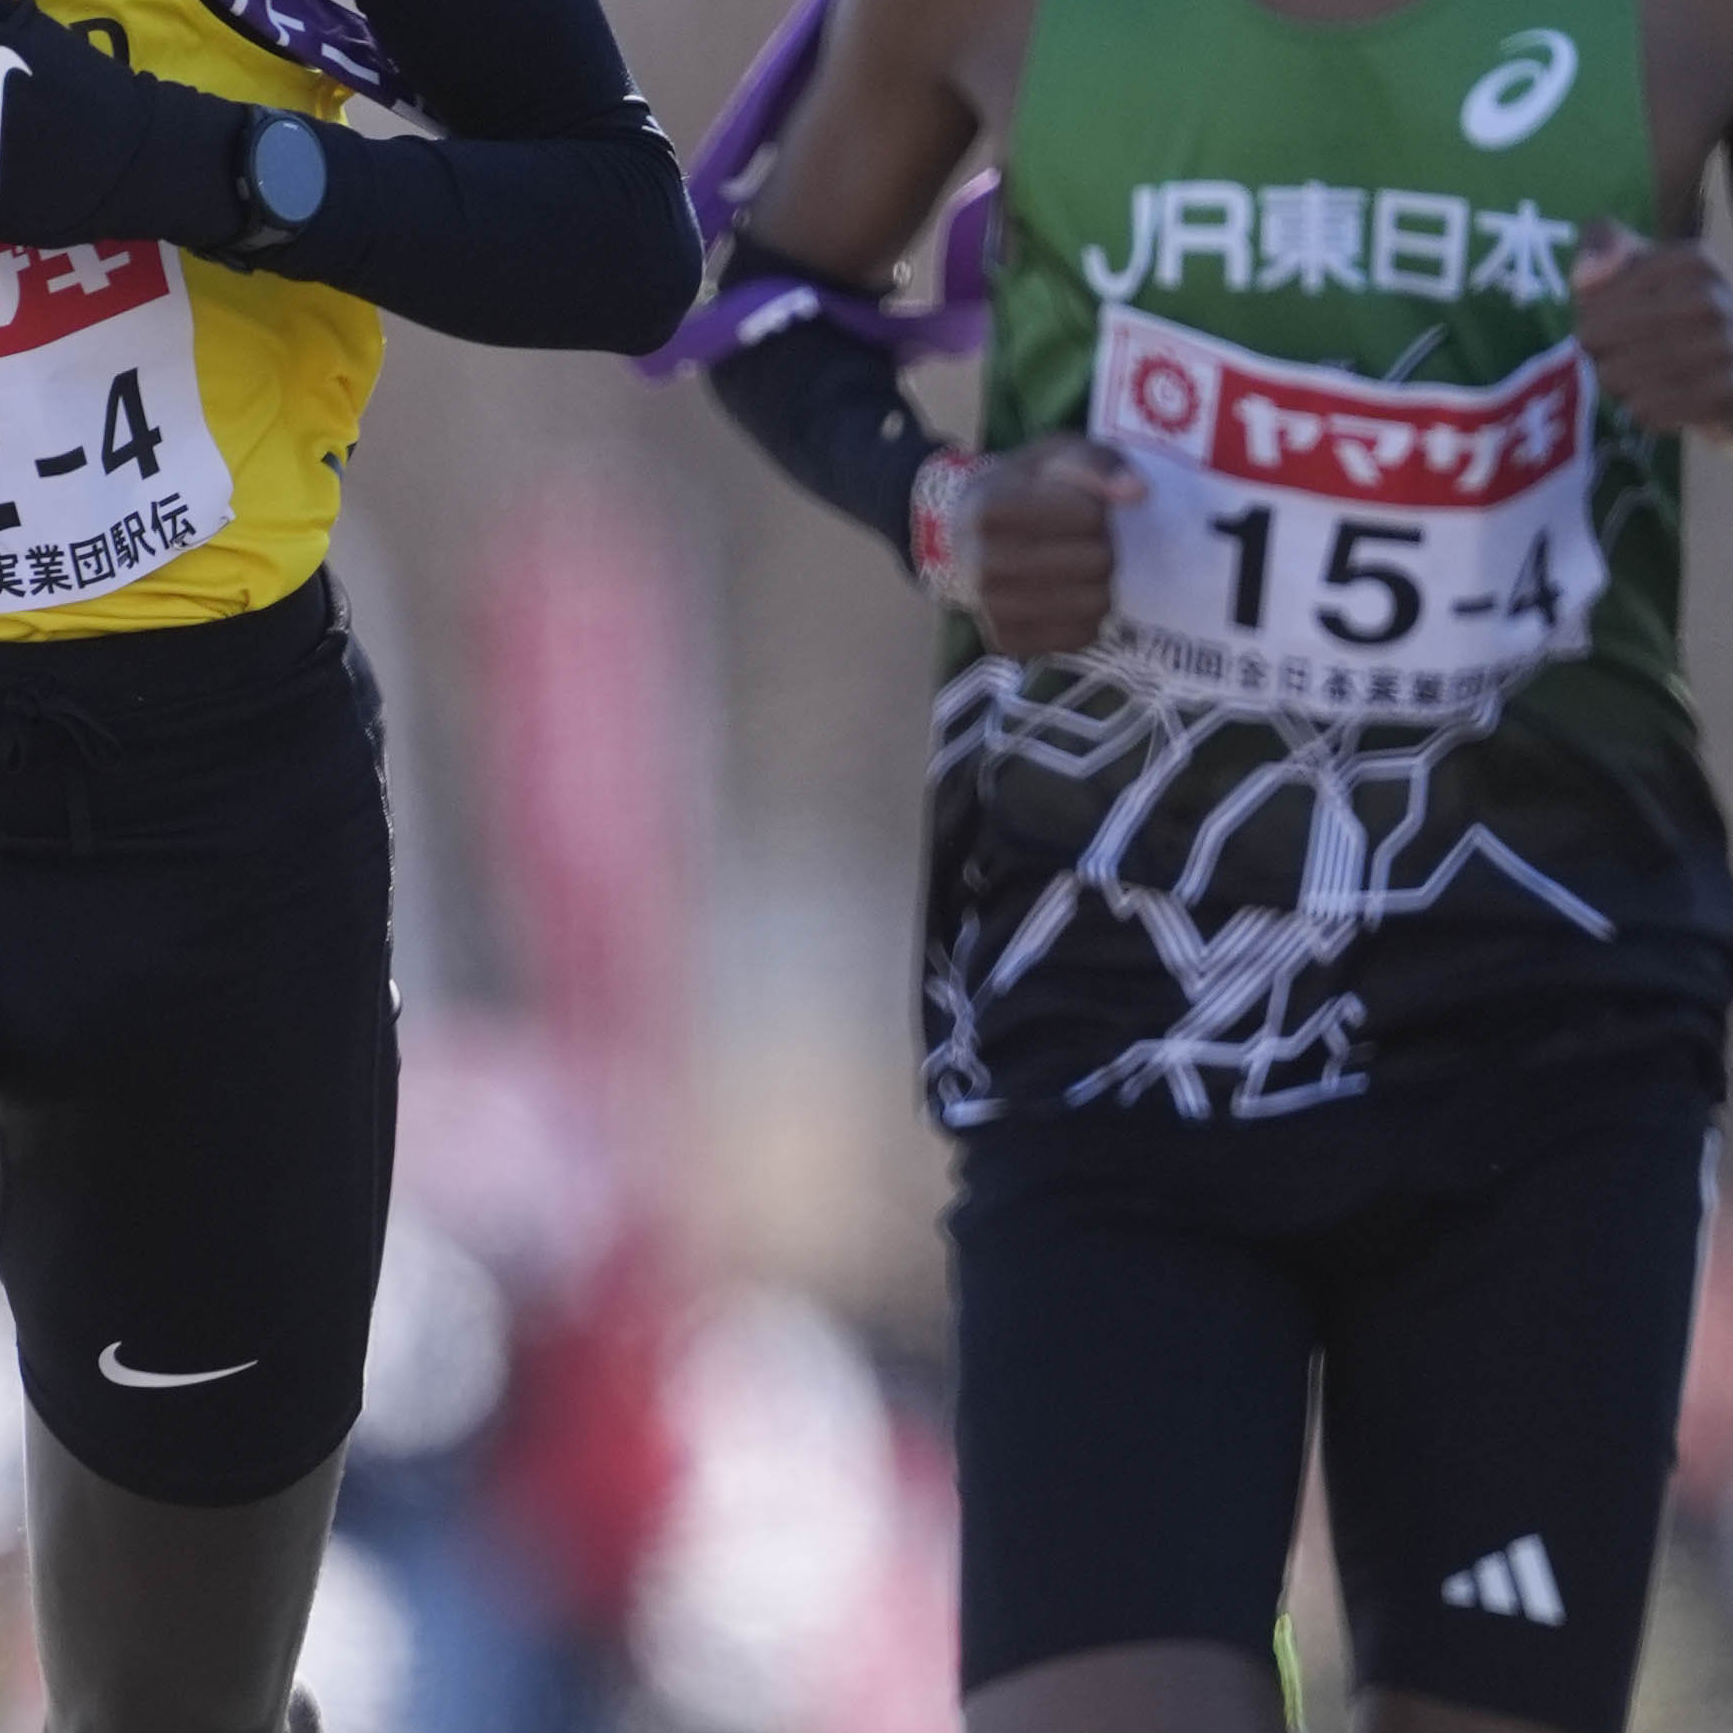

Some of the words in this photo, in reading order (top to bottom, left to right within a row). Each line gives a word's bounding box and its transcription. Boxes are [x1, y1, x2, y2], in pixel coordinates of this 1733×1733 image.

[1080, 178, 1577, 307] JR東日本
[1233, 385, 1569, 494] ヤマザキ
[1208, 500, 1564, 650] 15-4
